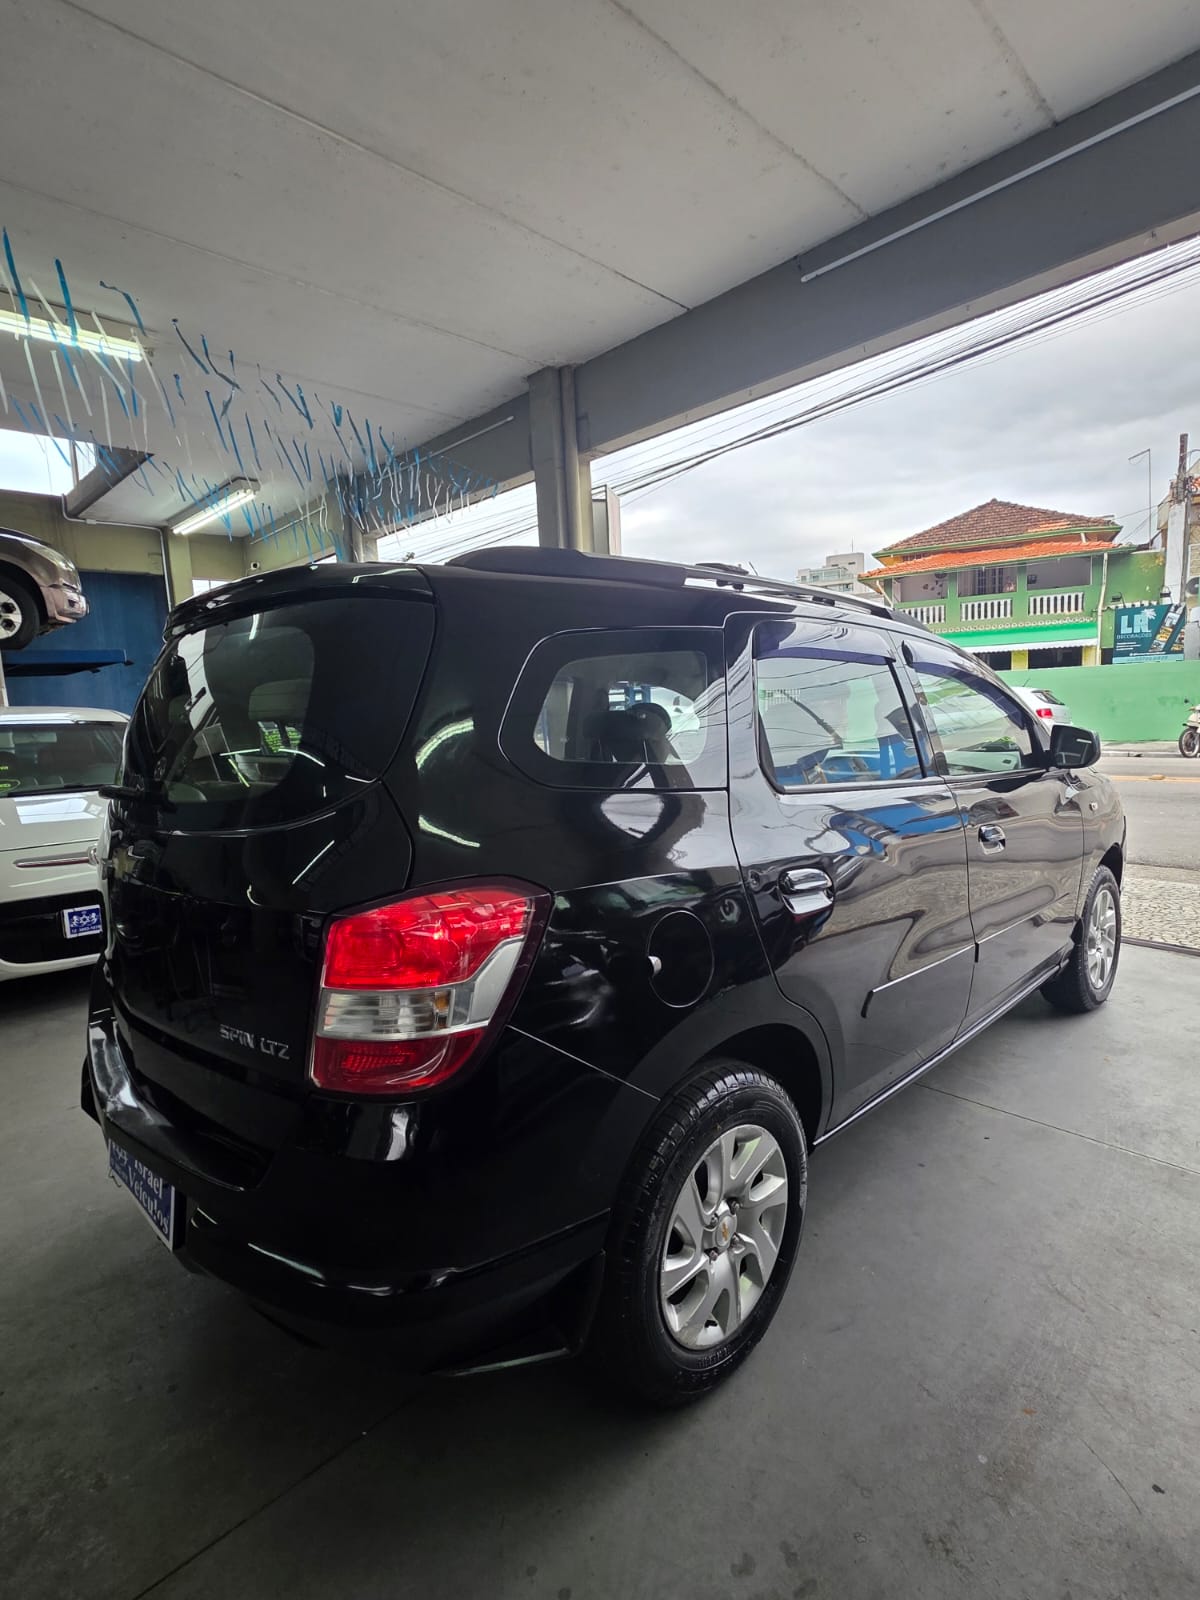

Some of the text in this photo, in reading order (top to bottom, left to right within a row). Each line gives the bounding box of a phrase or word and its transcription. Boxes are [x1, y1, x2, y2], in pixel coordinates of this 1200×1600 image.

[1121, 613, 1151, 634] LR
[220, 1024, 290, 1060] SPIN LTZ
